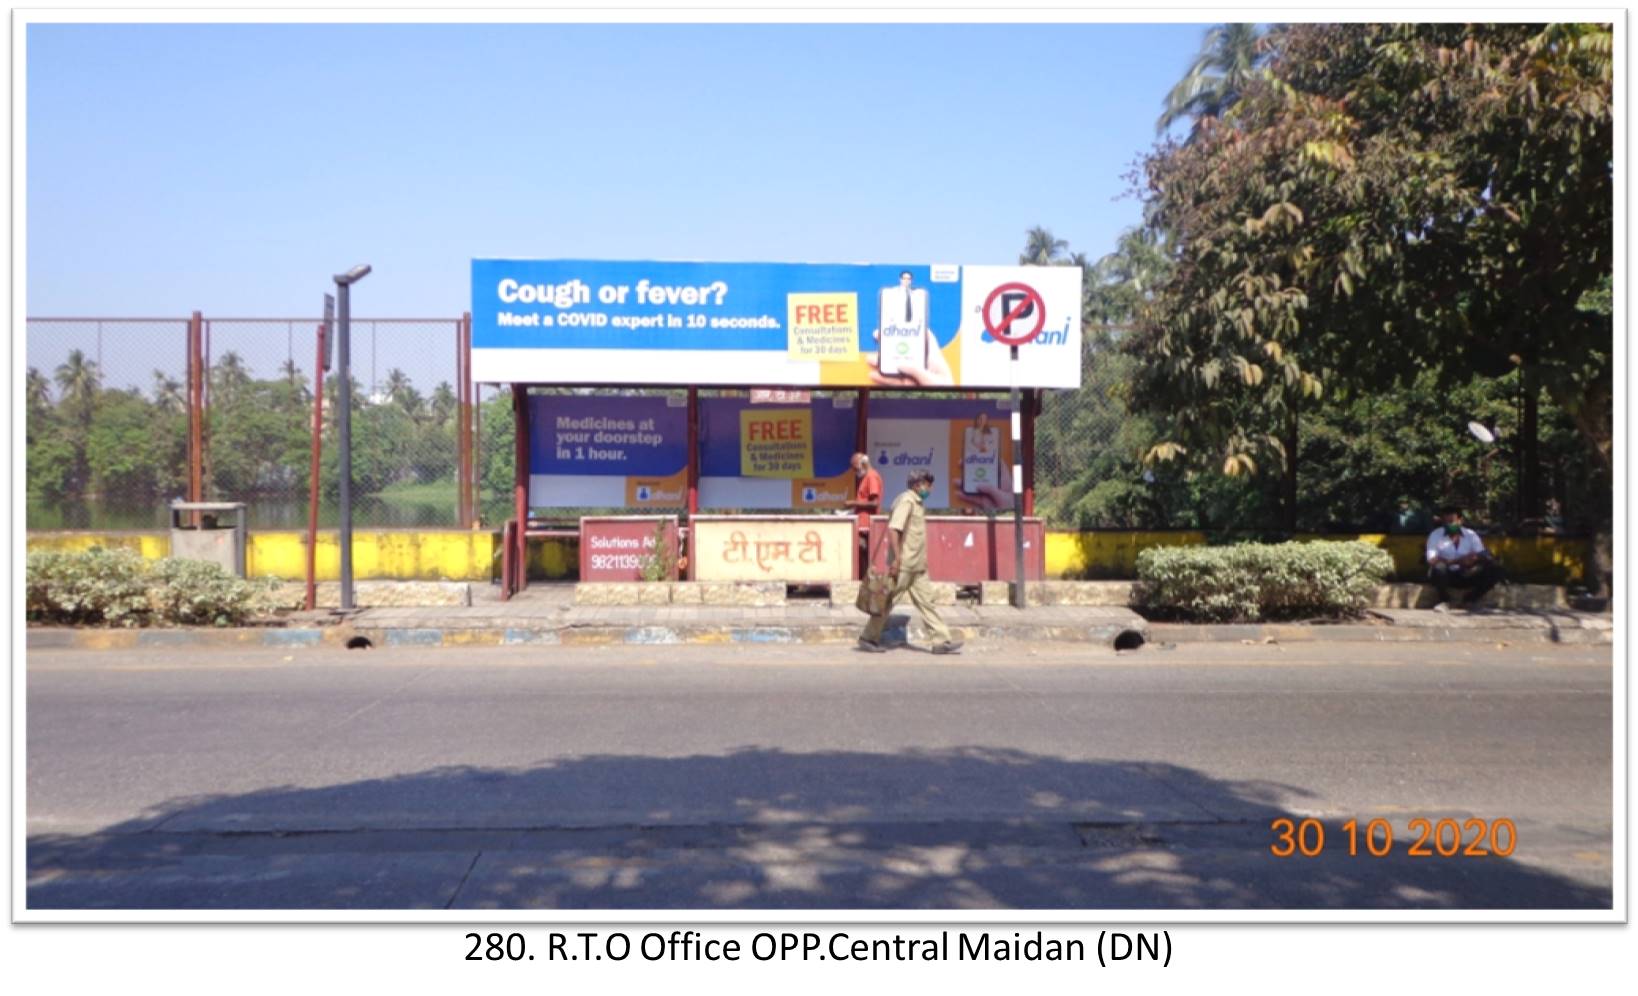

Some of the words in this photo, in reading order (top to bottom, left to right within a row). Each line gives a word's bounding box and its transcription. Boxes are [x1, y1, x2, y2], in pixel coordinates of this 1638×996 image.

[498, 279, 590, 308] Cough
[598, 285, 629, 304] or
[636, 280, 728, 305] fever?
[498, 312, 539, 327] Meet
[543, 316, 553, 327] a
[557, 312, 608, 328] COVID
[611, 314, 663, 330] expert
[668, 314, 682, 328] in
[687, 314, 707, 328] 10
[710, 315, 781, 330] seconds.
[796, 304, 849, 324] FREE
[793, 325, 853, 335] Consultations
[883, 319, 922, 337] dhani
[807, 335, 851, 344] Medicines
[829, 346, 848, 355] days
[556, 417, 635, 430] Medicines
[640, 418, 655, 430] at
[749, 419, 803, 441] FREE
[556, 432, 591, 446] your
[593, 431, 663, 447] doorstep
[556, 446, 571, 460] in
[575, 447, 585, 460] 1
[588, 446, 627, 460] hour.
[747, 442, 807, 451] Consultations
[760, 451, 804, 461] Medicines
[893, 447, 934, 465] dhani
[965, 449, 996, 464] dhani
[591, 536, 639, 549] Solutions
